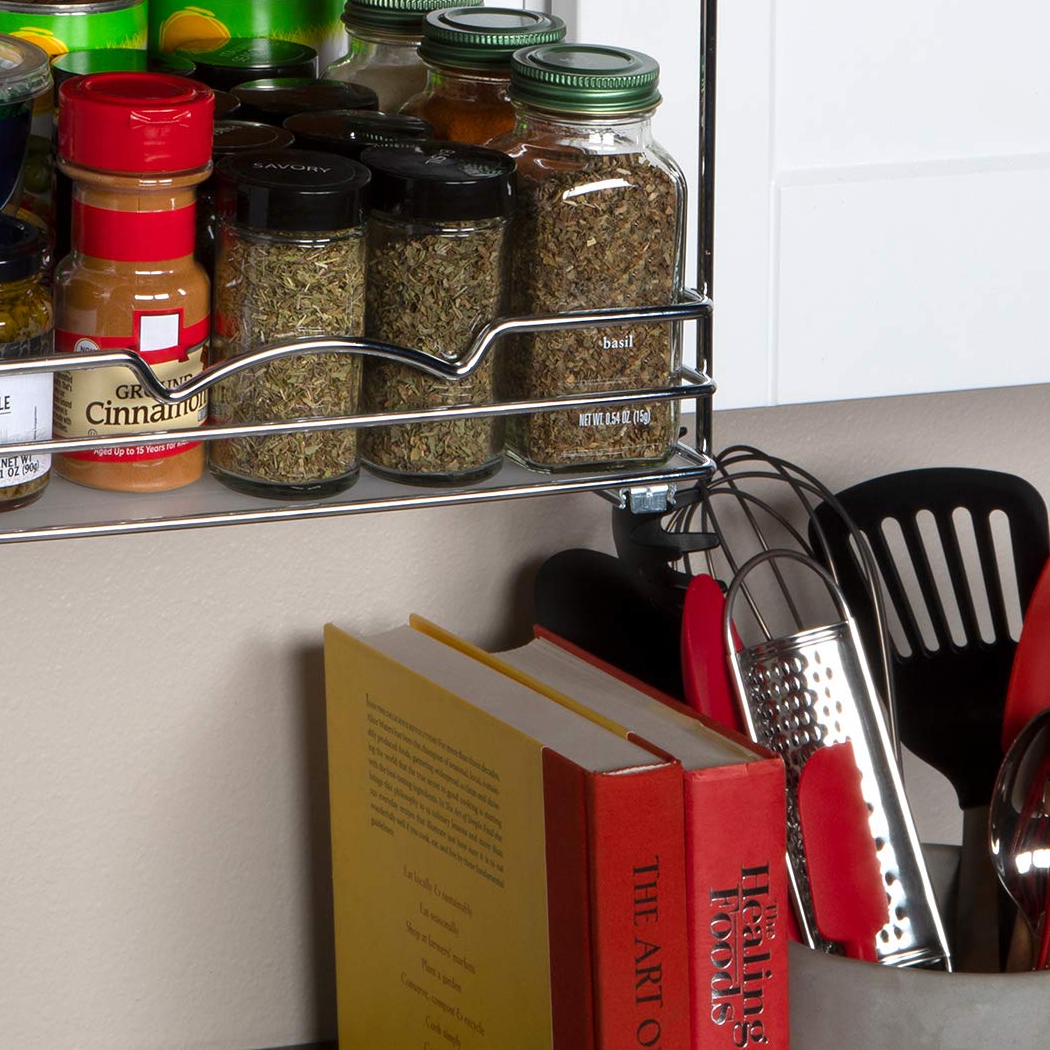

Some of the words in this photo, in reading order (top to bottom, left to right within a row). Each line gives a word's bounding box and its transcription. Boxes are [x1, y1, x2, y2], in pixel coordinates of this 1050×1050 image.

[253, 161, 332, 174] SAVORY
[603, 335, 633, 349] basil
[86, 390, 206, 426] Cinnamon
[579, 413, 592, 427] NET
[606, 412, 620, 425] 0.54
[633, 410, 651, 426] (15g)
[1, 456, 18, 468] NET
[114, 448, 124, 457] Up
[136, 447, 144, 455] 15
[146, 445, 165, 454] Years
[8, 466, 20, 477] OZ
[22, 461, 40, 476] (90g)
[633, 855, 659, 926] THE
[765, 898, 778, 940] The
[710, 883, 742, 1026] Foods
[733, 861, 772, 1048] Healing
[634, 938, 662, 1009] ART
